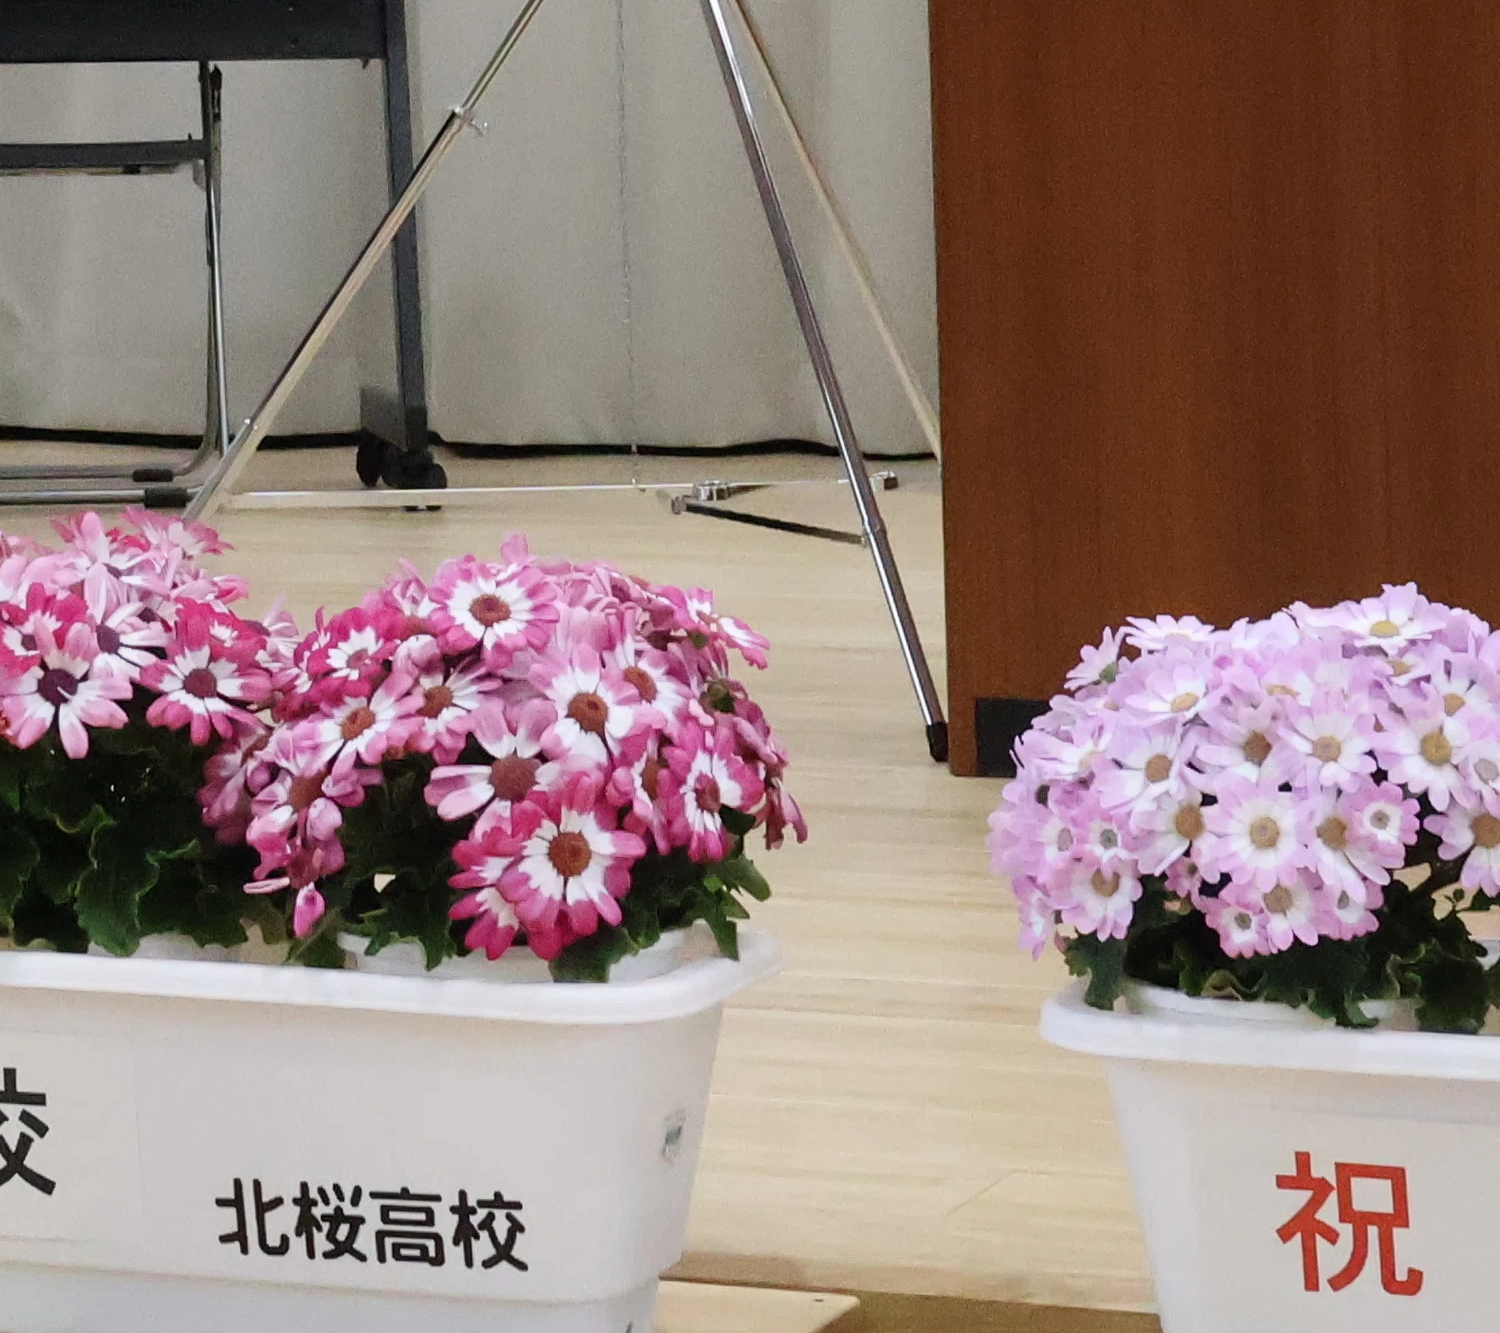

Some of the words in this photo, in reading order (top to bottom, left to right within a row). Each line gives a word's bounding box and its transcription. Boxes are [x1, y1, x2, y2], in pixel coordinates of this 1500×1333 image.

[214, 1177, 530, 1273] 北桜高校
[1275, 1151, 1425, 1297] 祝
